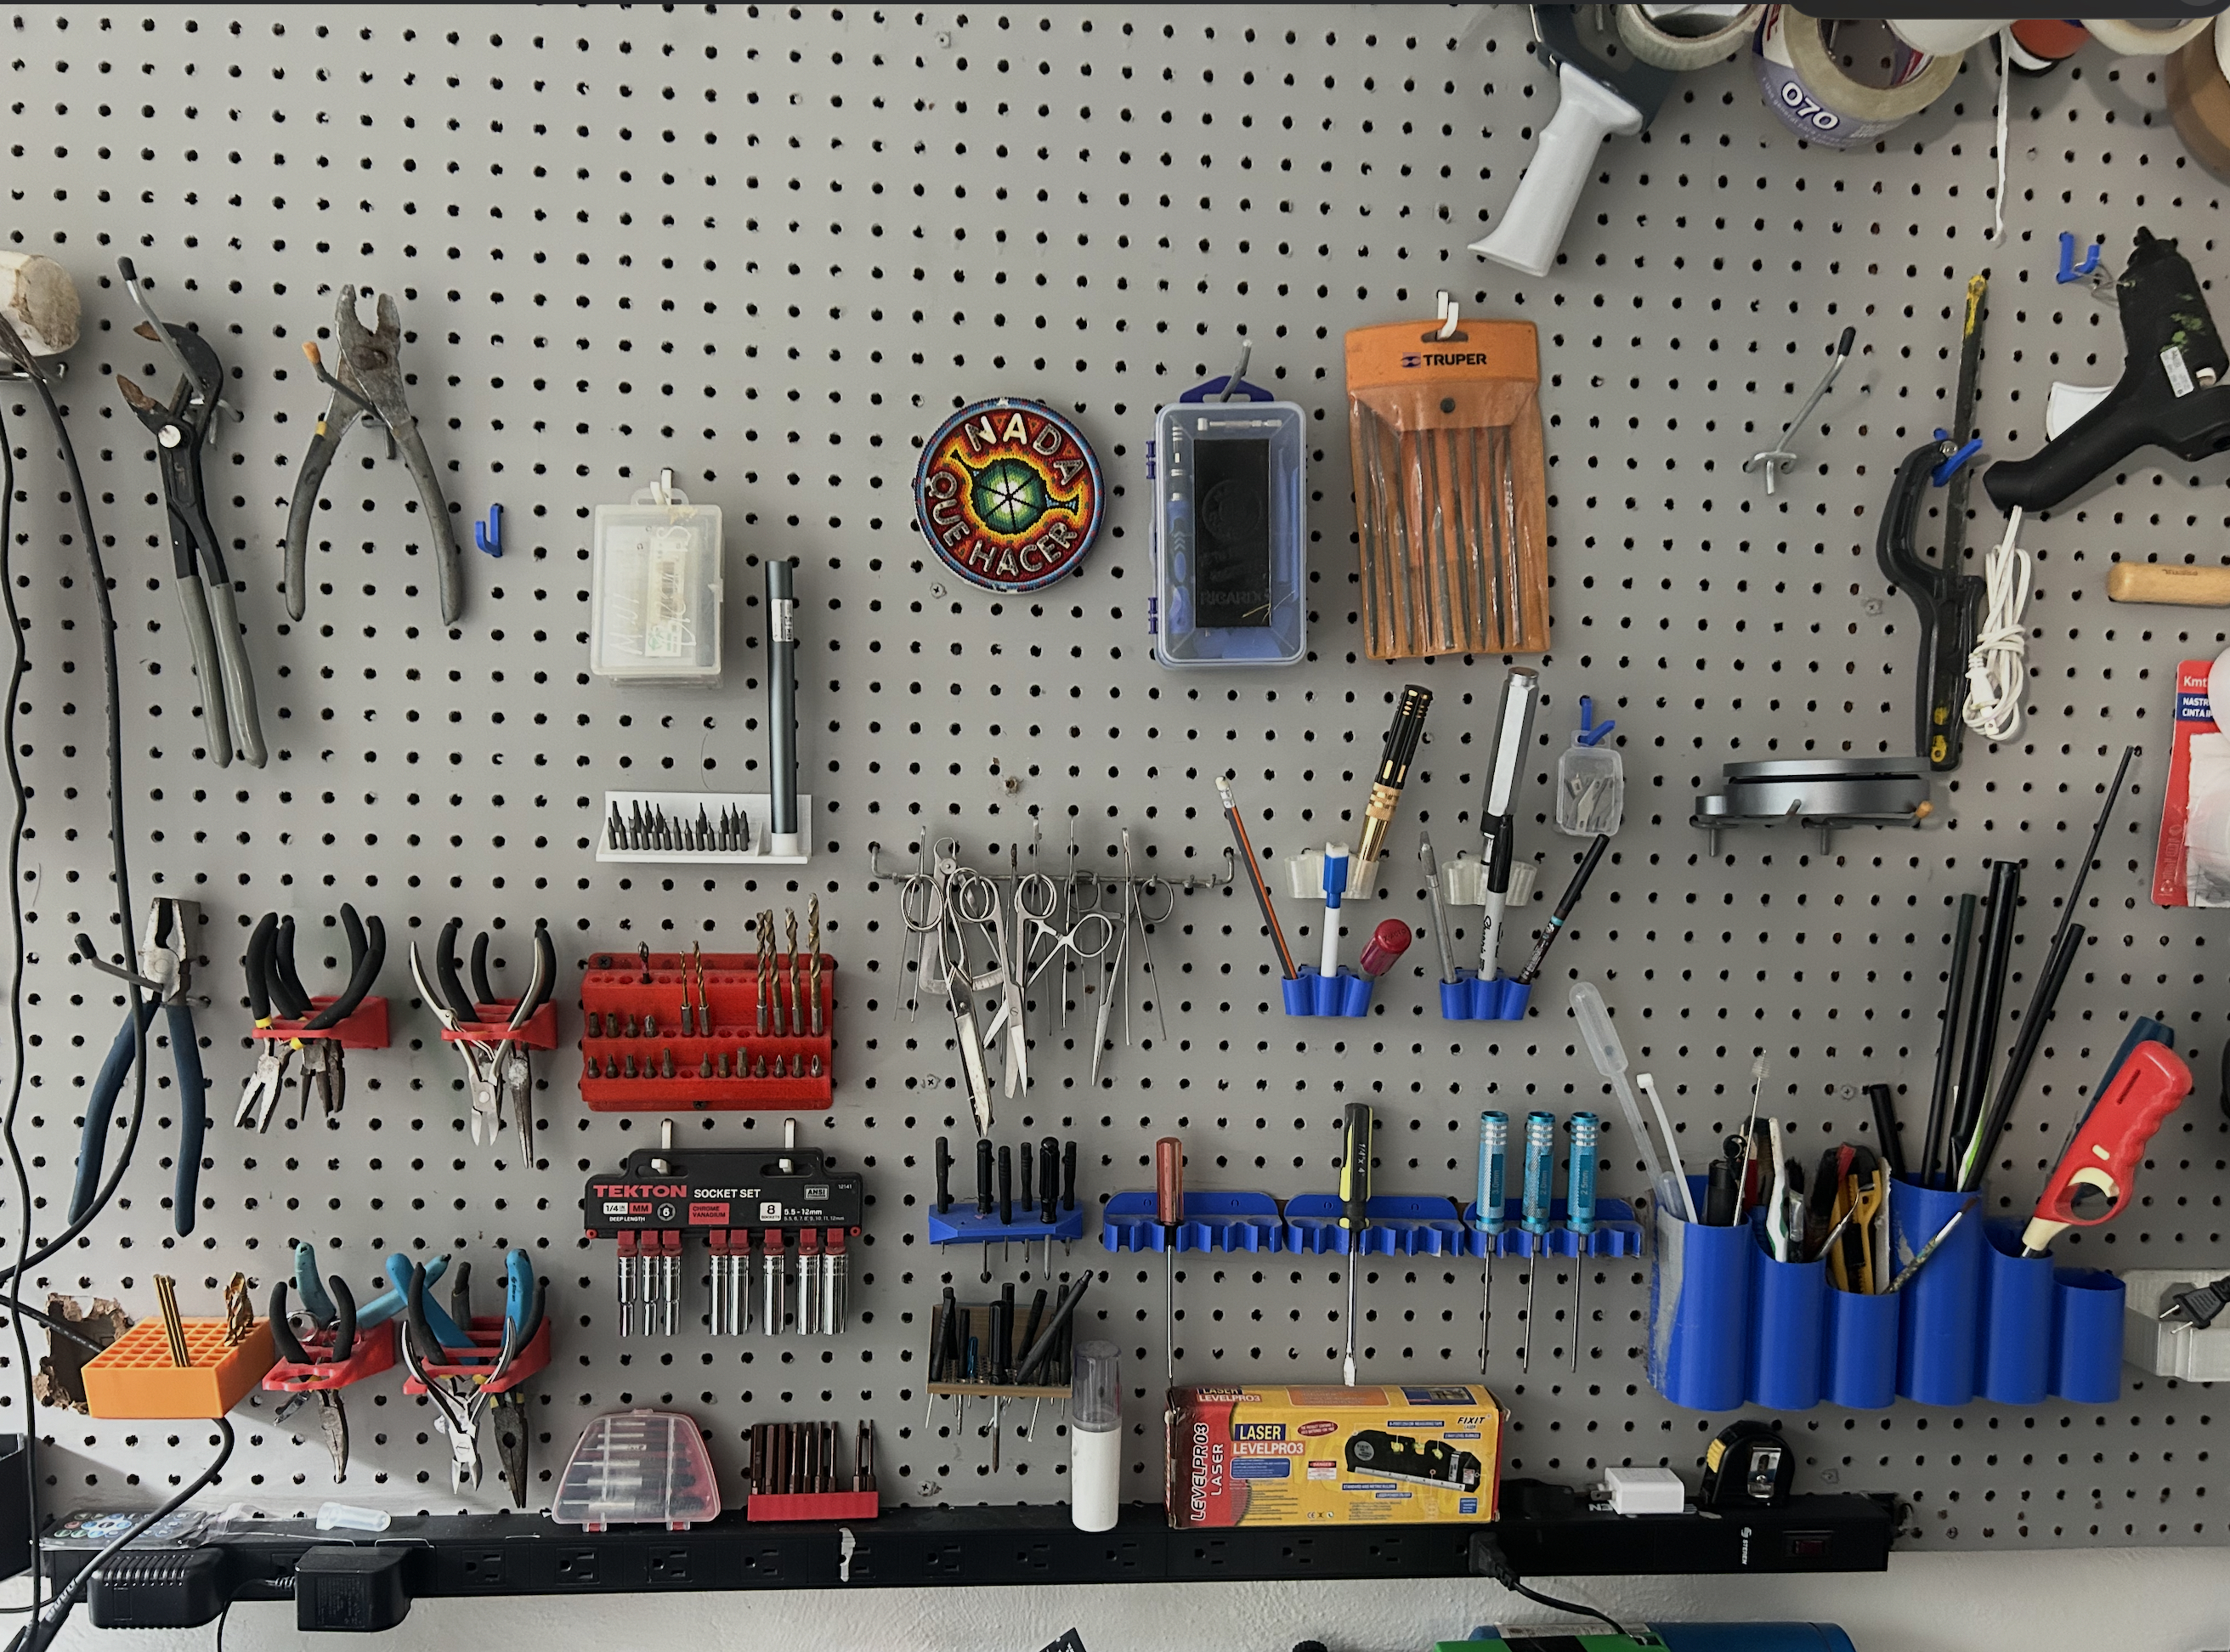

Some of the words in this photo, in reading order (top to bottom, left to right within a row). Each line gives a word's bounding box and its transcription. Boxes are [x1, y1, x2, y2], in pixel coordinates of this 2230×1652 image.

[1423, 353, 1487, 366] TRUPER
[965, 412, 1084, 485] NADA
[925, 471, 970, 547] QUE
[969, 521, 1078, 577] HACER
[593, 1185, 687, 1198] TEKTON
[693, 1189, 738, 1199] SOCKET
[739, 1189, 761, 1198] SET
[662, 1207, 671, 1217] 6
[767, 1204, 775, 1214] 8
[1240, 1425, 1282, 1440] LASER
[1232, 1441, 1304, 1454] LEVELPRO3
[1191, 1422, 1208, 1521] LEVELPRO3
[1211, 1443, 1224, 1496] LASER
